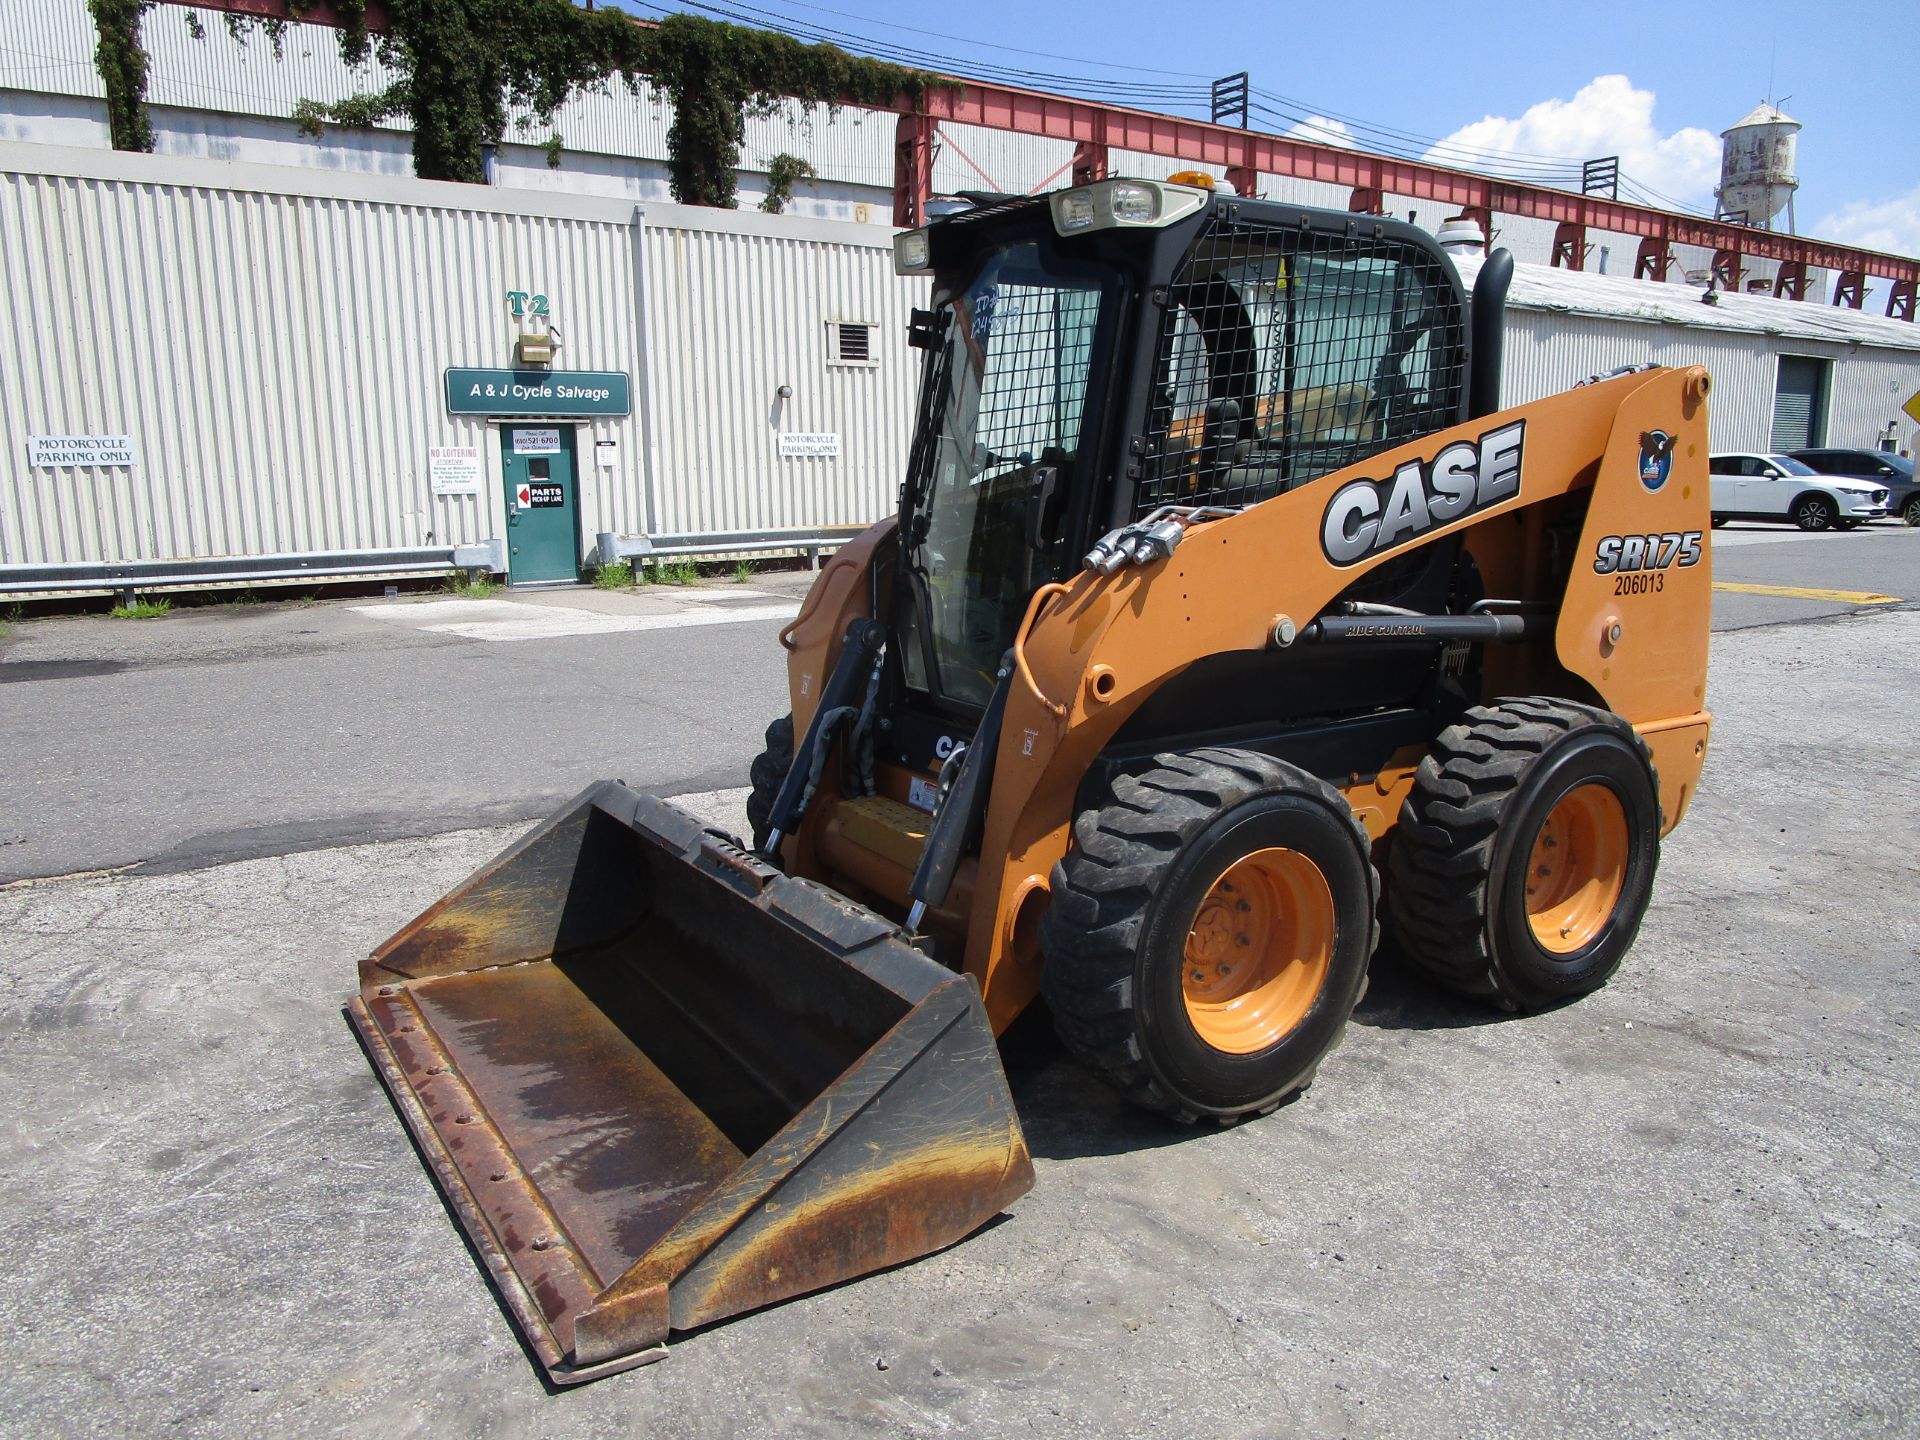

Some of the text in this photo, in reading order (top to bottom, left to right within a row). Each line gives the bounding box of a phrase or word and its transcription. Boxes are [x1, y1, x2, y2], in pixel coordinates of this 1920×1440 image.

[470, 384, 610, 402] A & J Cycle Salvage
[39, 439, 127, 449] MOTORCYCLE
[784, 435, 836, 443] MOTORCYCLE
[430, 448, 477, 457] NO LOITERING
[782, 445, 838, 453] PARKING ONLY
[36, 451, 132, 462] PARKING ONLY
[531, 488, 562, 496] PARTS
[1322, 422, 1524, 564] CASE
[1594, 531, 1702, 574] SR175
[1614, 573, 1664, 596] 206013
[1345, 624, 1425, 636] RIDE CONTROL
